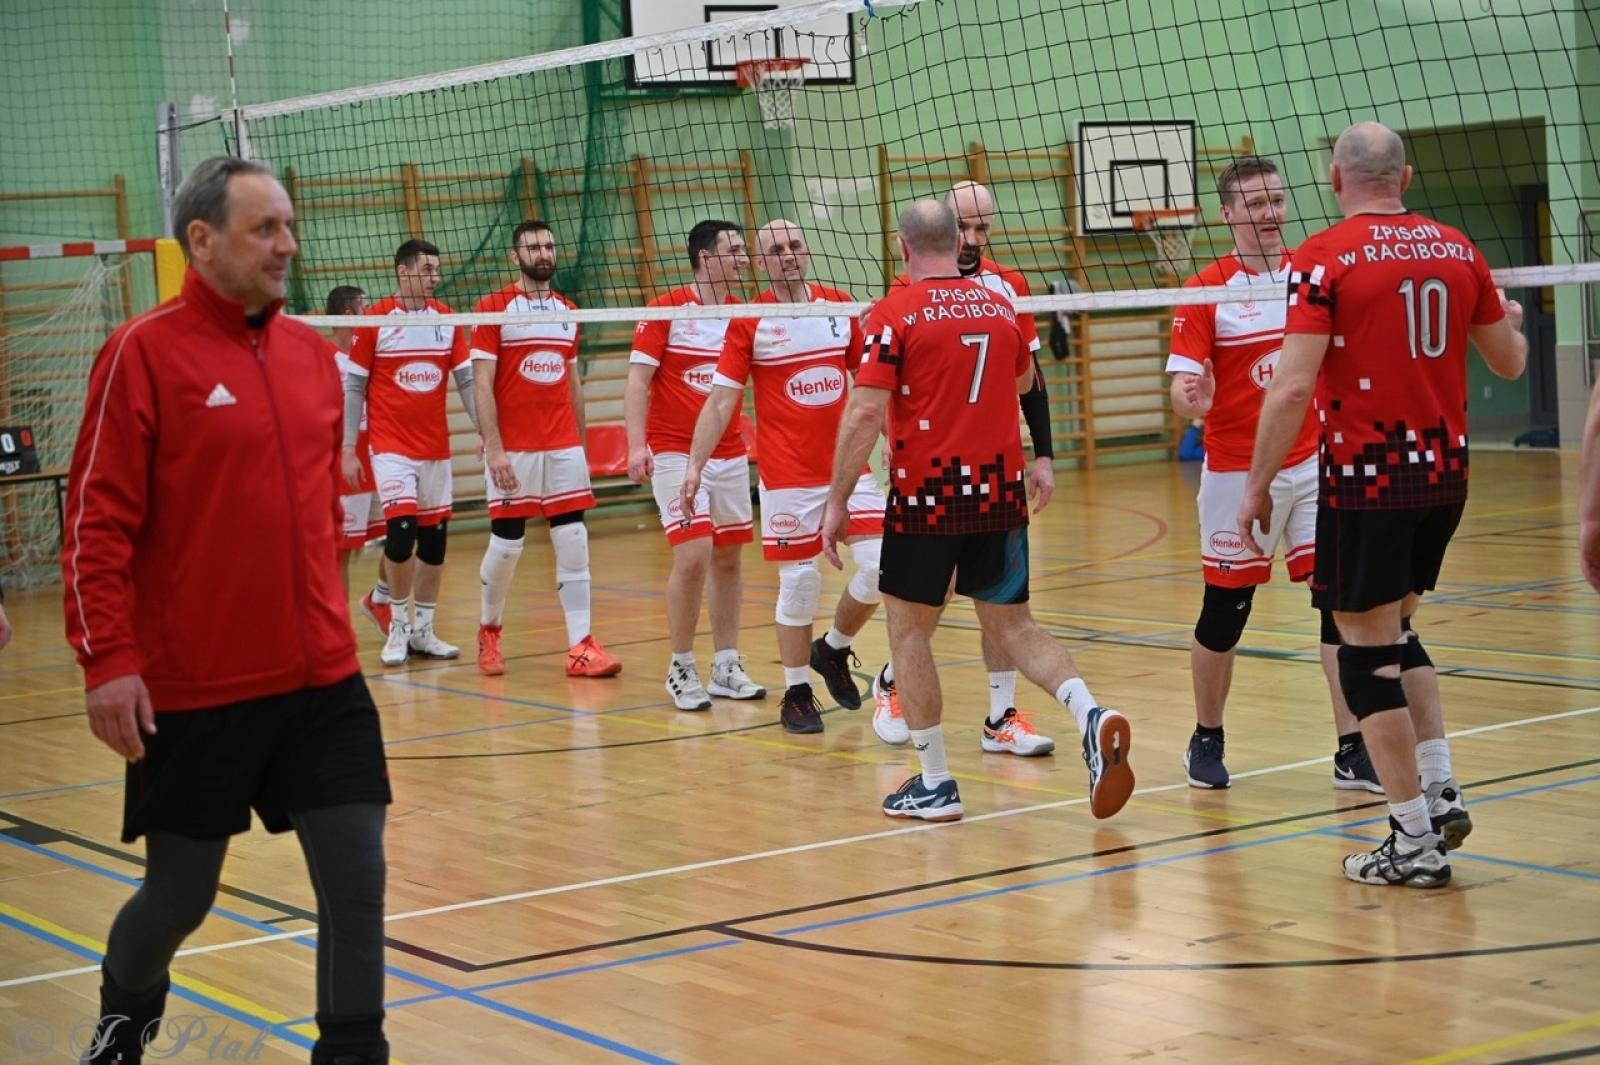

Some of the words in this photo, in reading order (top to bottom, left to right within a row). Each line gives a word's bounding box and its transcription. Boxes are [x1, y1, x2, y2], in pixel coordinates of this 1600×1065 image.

[1397, 277, 1448, 359] 10
[523, 359, 562, 374] Henke
[790, 374, 843, 397] Henkel
[959, 332, 990, 405] 7
